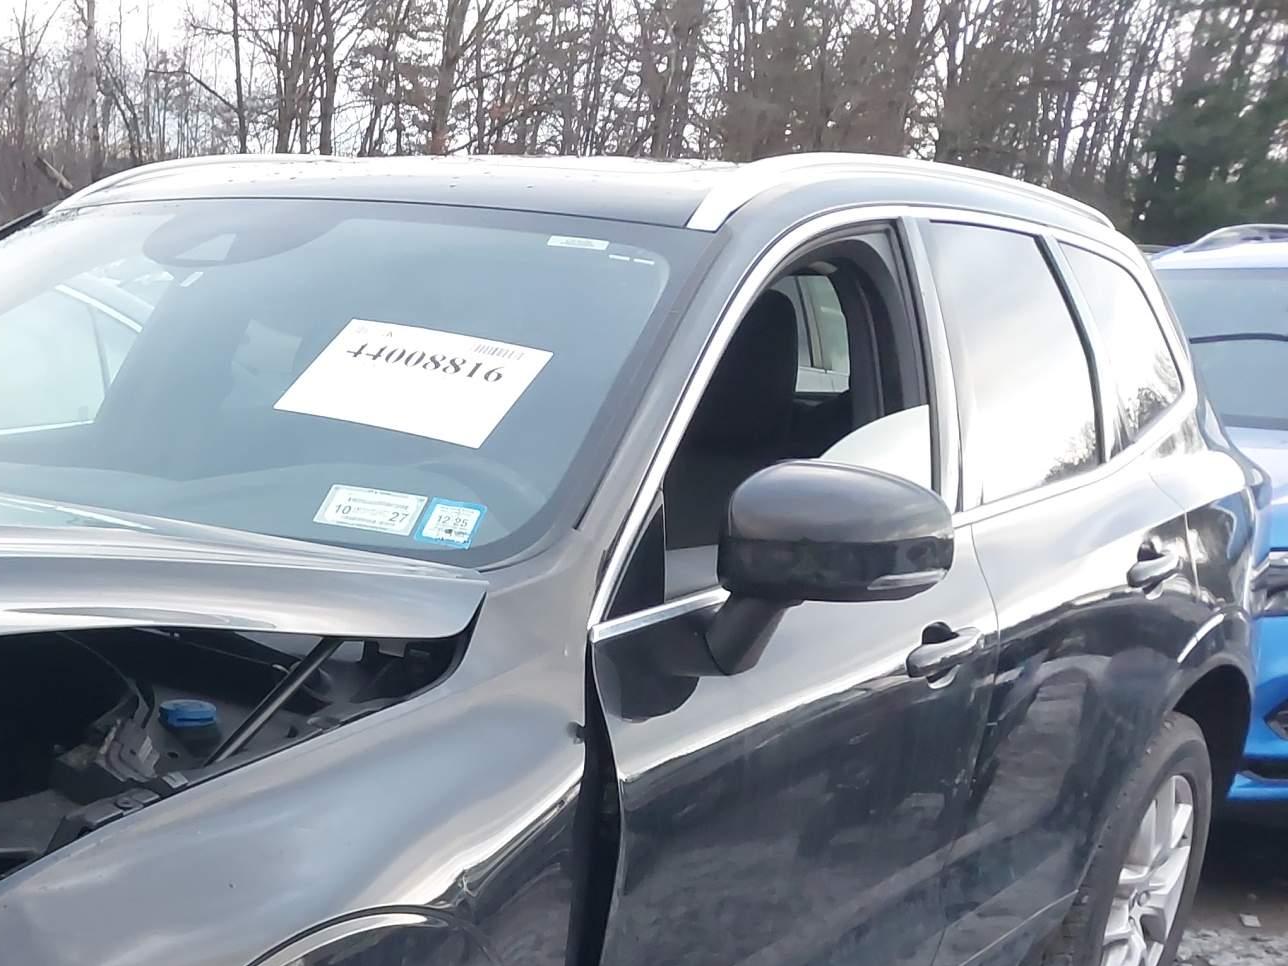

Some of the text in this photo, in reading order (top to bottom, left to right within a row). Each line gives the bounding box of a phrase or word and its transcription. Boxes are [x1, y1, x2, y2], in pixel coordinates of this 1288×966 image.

[346, 343, 505, 382] 44008816
[335, 503, 352, 515] 10
[388, 511, 410, 523] 27
[437, 514, 451, 524] 12
